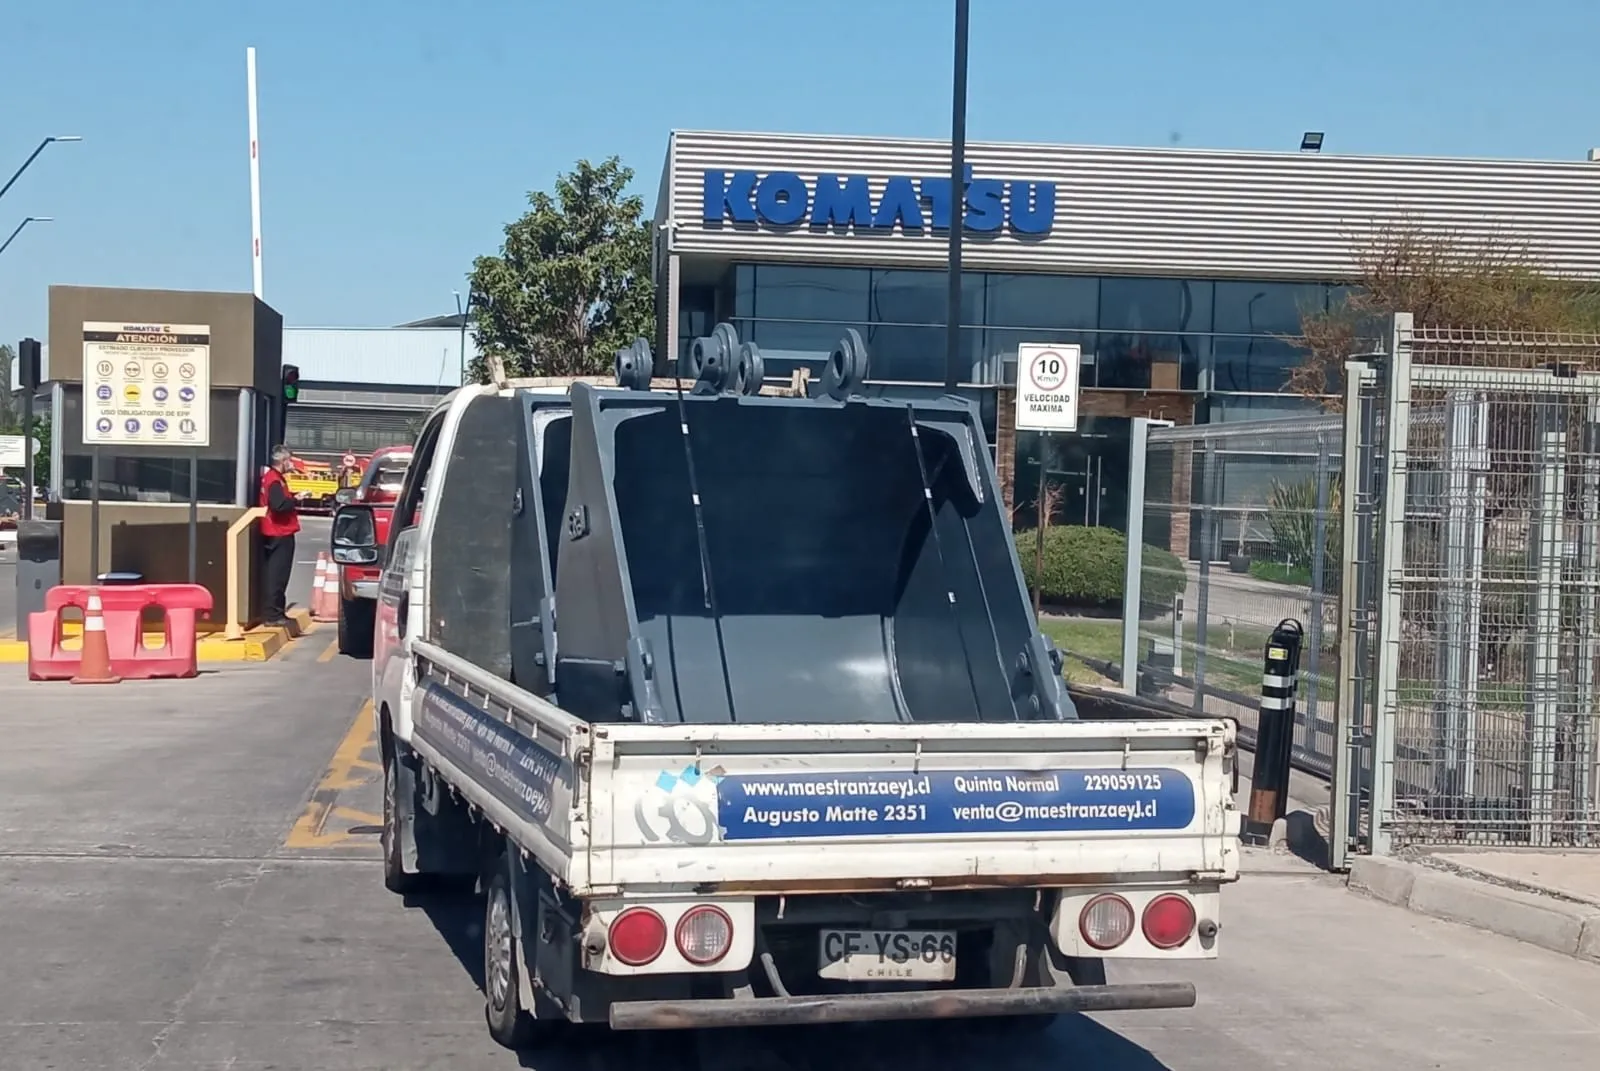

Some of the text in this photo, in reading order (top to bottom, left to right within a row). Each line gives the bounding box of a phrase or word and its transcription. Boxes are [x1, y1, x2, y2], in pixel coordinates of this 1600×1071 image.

[703, 163, 1056, 235] KOMATSU
[1038, 359, 1060, 374] 10
[1024, 394, 1070, 402] VELOCIDAD
[1030, 404, 1063, 412] MAXIMA
[953, 776, 1002, 793] Quinta
[1006, 775, 1059, 793] Normal
[1084, 774, 1162, 791] 229059125
[743, 806, 820, 827] Augusto
[825, 808, 878, 822] Matte
[883, 804, 927, 821] 2351
[867, 968, 913, 977] CHILE
